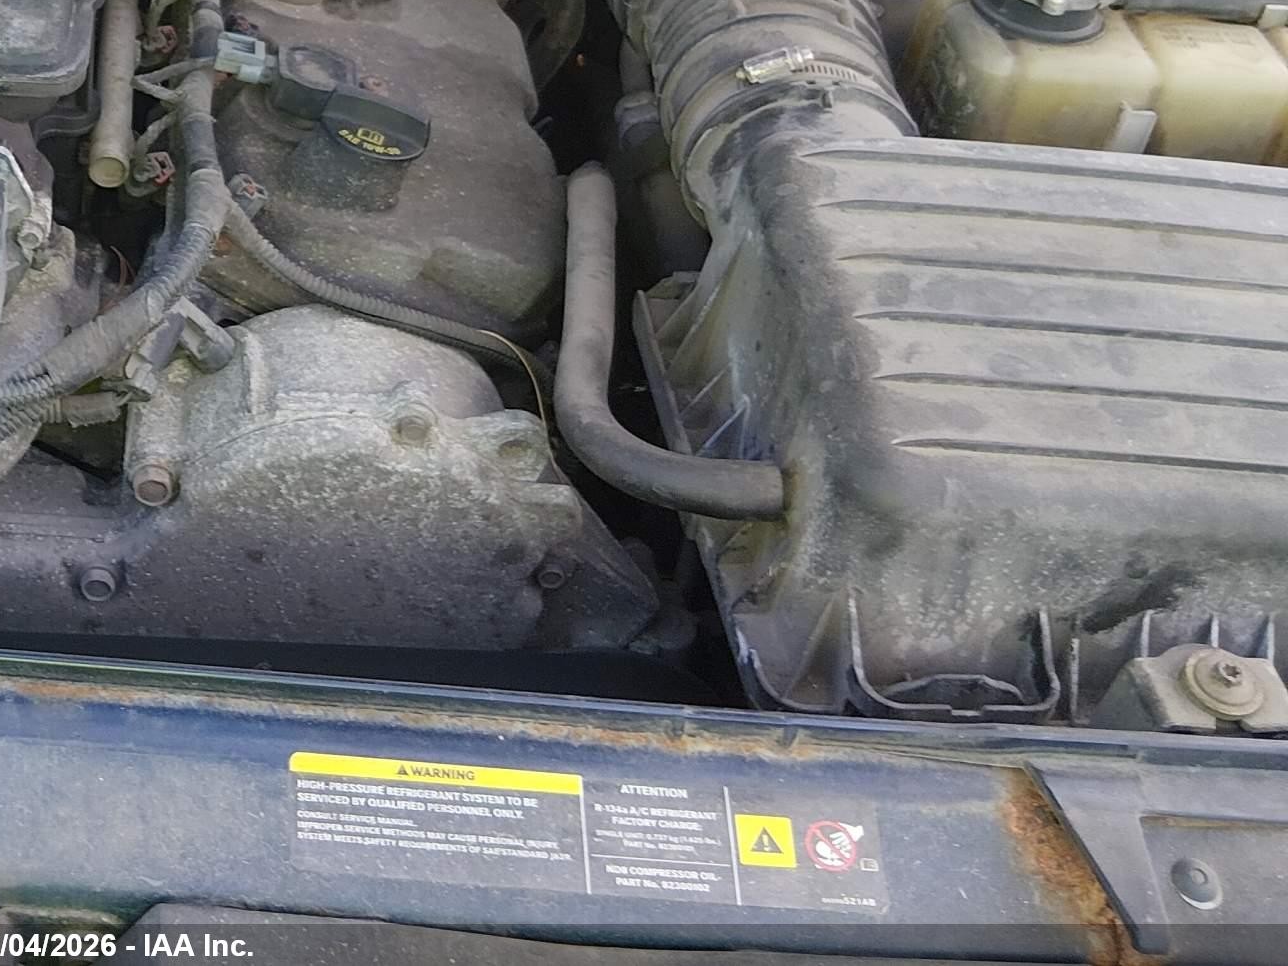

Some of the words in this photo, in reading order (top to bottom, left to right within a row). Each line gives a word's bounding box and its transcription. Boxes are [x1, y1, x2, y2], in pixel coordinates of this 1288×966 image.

[410, 766, 475, 781] WARNING
[297, 779, 385, 794] HIGH-PRESSURE
[386, 786, 460, 801] REFRIGERANT
[462, 792, 504, 804] SYSTEM
[506, 796, 521, 806] TO
[523, 797, 538, 807] BE
[620, 784, 688, 798] ATTENTION
[297, 792, 350, 804] SERVICED
[352, 796, 366, 806] BY
[367, 797, 426, 811] QUALIFIED
[427, 802, 492, 817] PERSONNEL
[629, 806, 649, 816] A/C
[650, 807, 717, 820] REFRIGERANT
[612, 816, 657, 827] FACTORY
[629, 866, 700, 880] COMPRESSOR
[615, 877, 641, 887] PART
